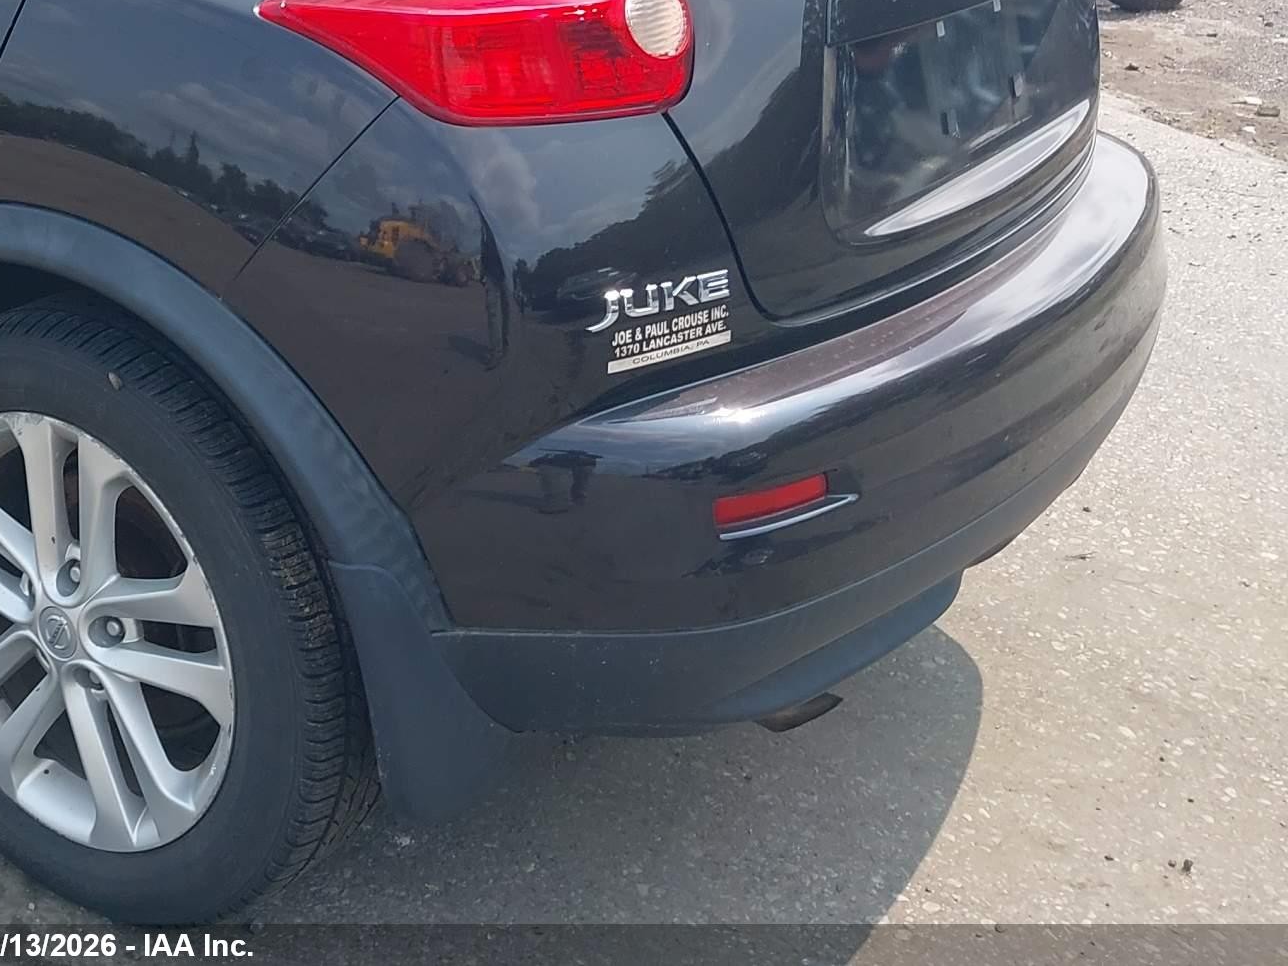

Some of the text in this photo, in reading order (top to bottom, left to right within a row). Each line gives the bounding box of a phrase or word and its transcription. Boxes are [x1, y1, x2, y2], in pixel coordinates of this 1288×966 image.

[585, 269, 730, 333] JUKE
[612, 304, 729, 347] JOE & PAUL CROUSE INC.
[614, 320, 727, 358] 1370 LANCASTER AVE.
[696, 339, 710, 347] PA
